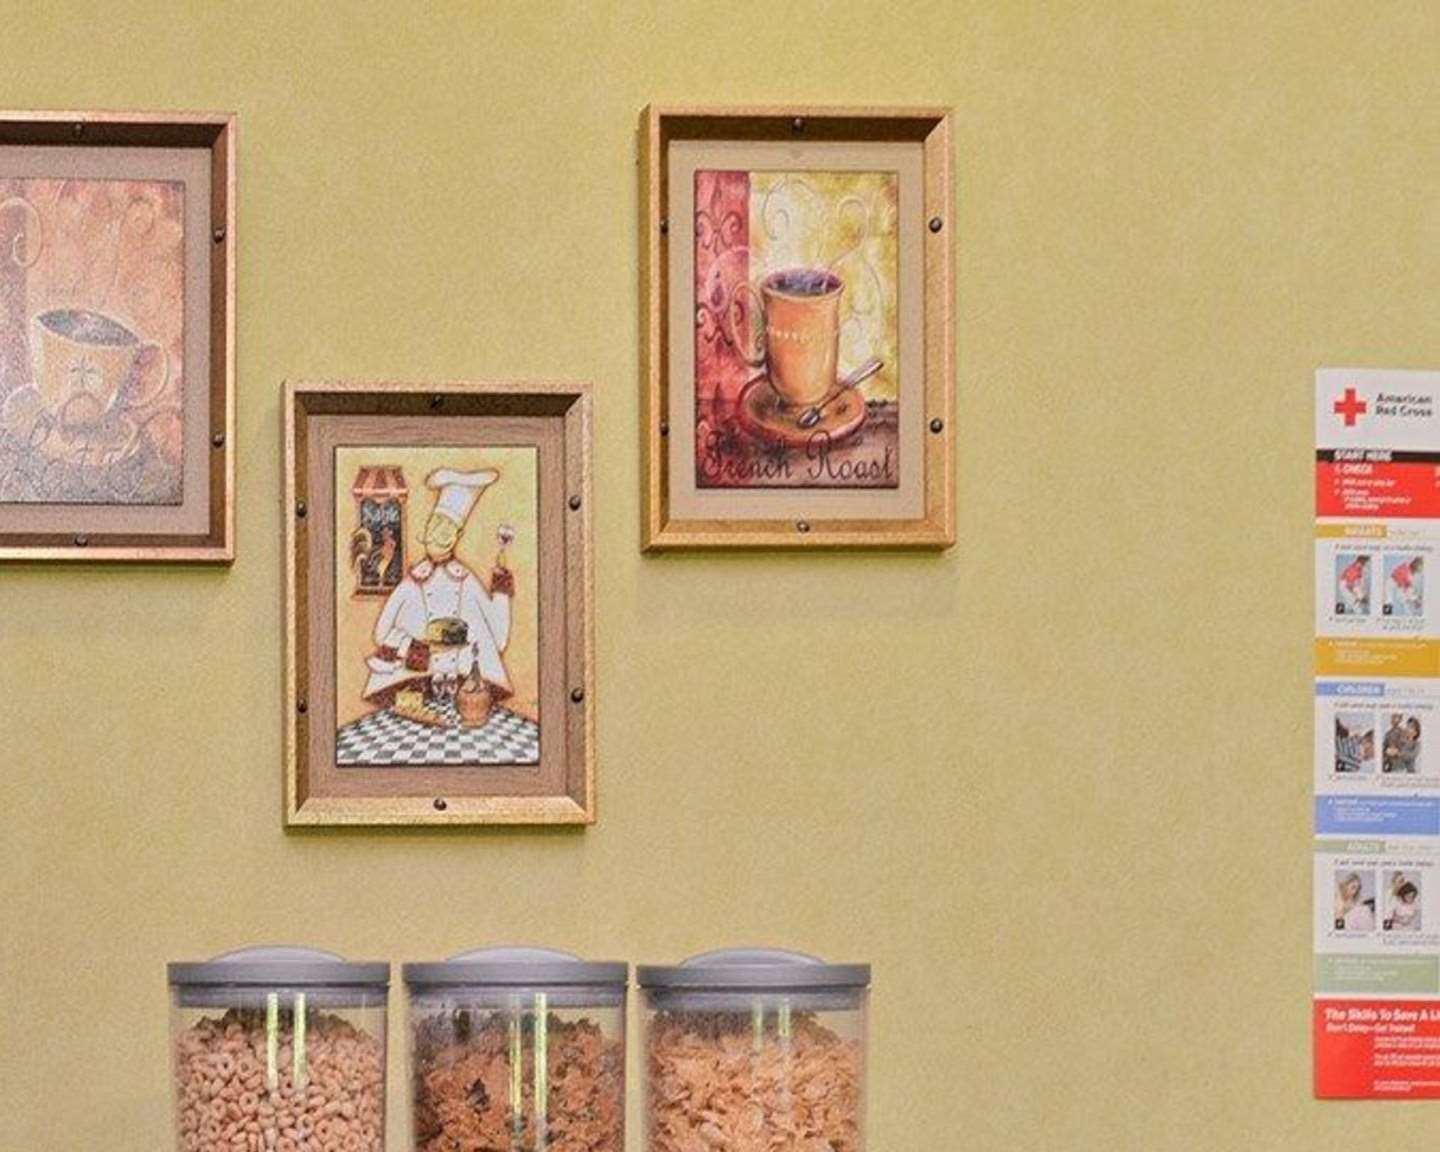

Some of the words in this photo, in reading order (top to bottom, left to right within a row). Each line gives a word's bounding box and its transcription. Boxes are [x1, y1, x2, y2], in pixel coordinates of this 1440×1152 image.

[1375, 393, 1433, 404] American
[1376, 405, 1397, 416] Red
[1400, 405, 1433, 417] Cross
[807, 430, 894, 480] Roast
